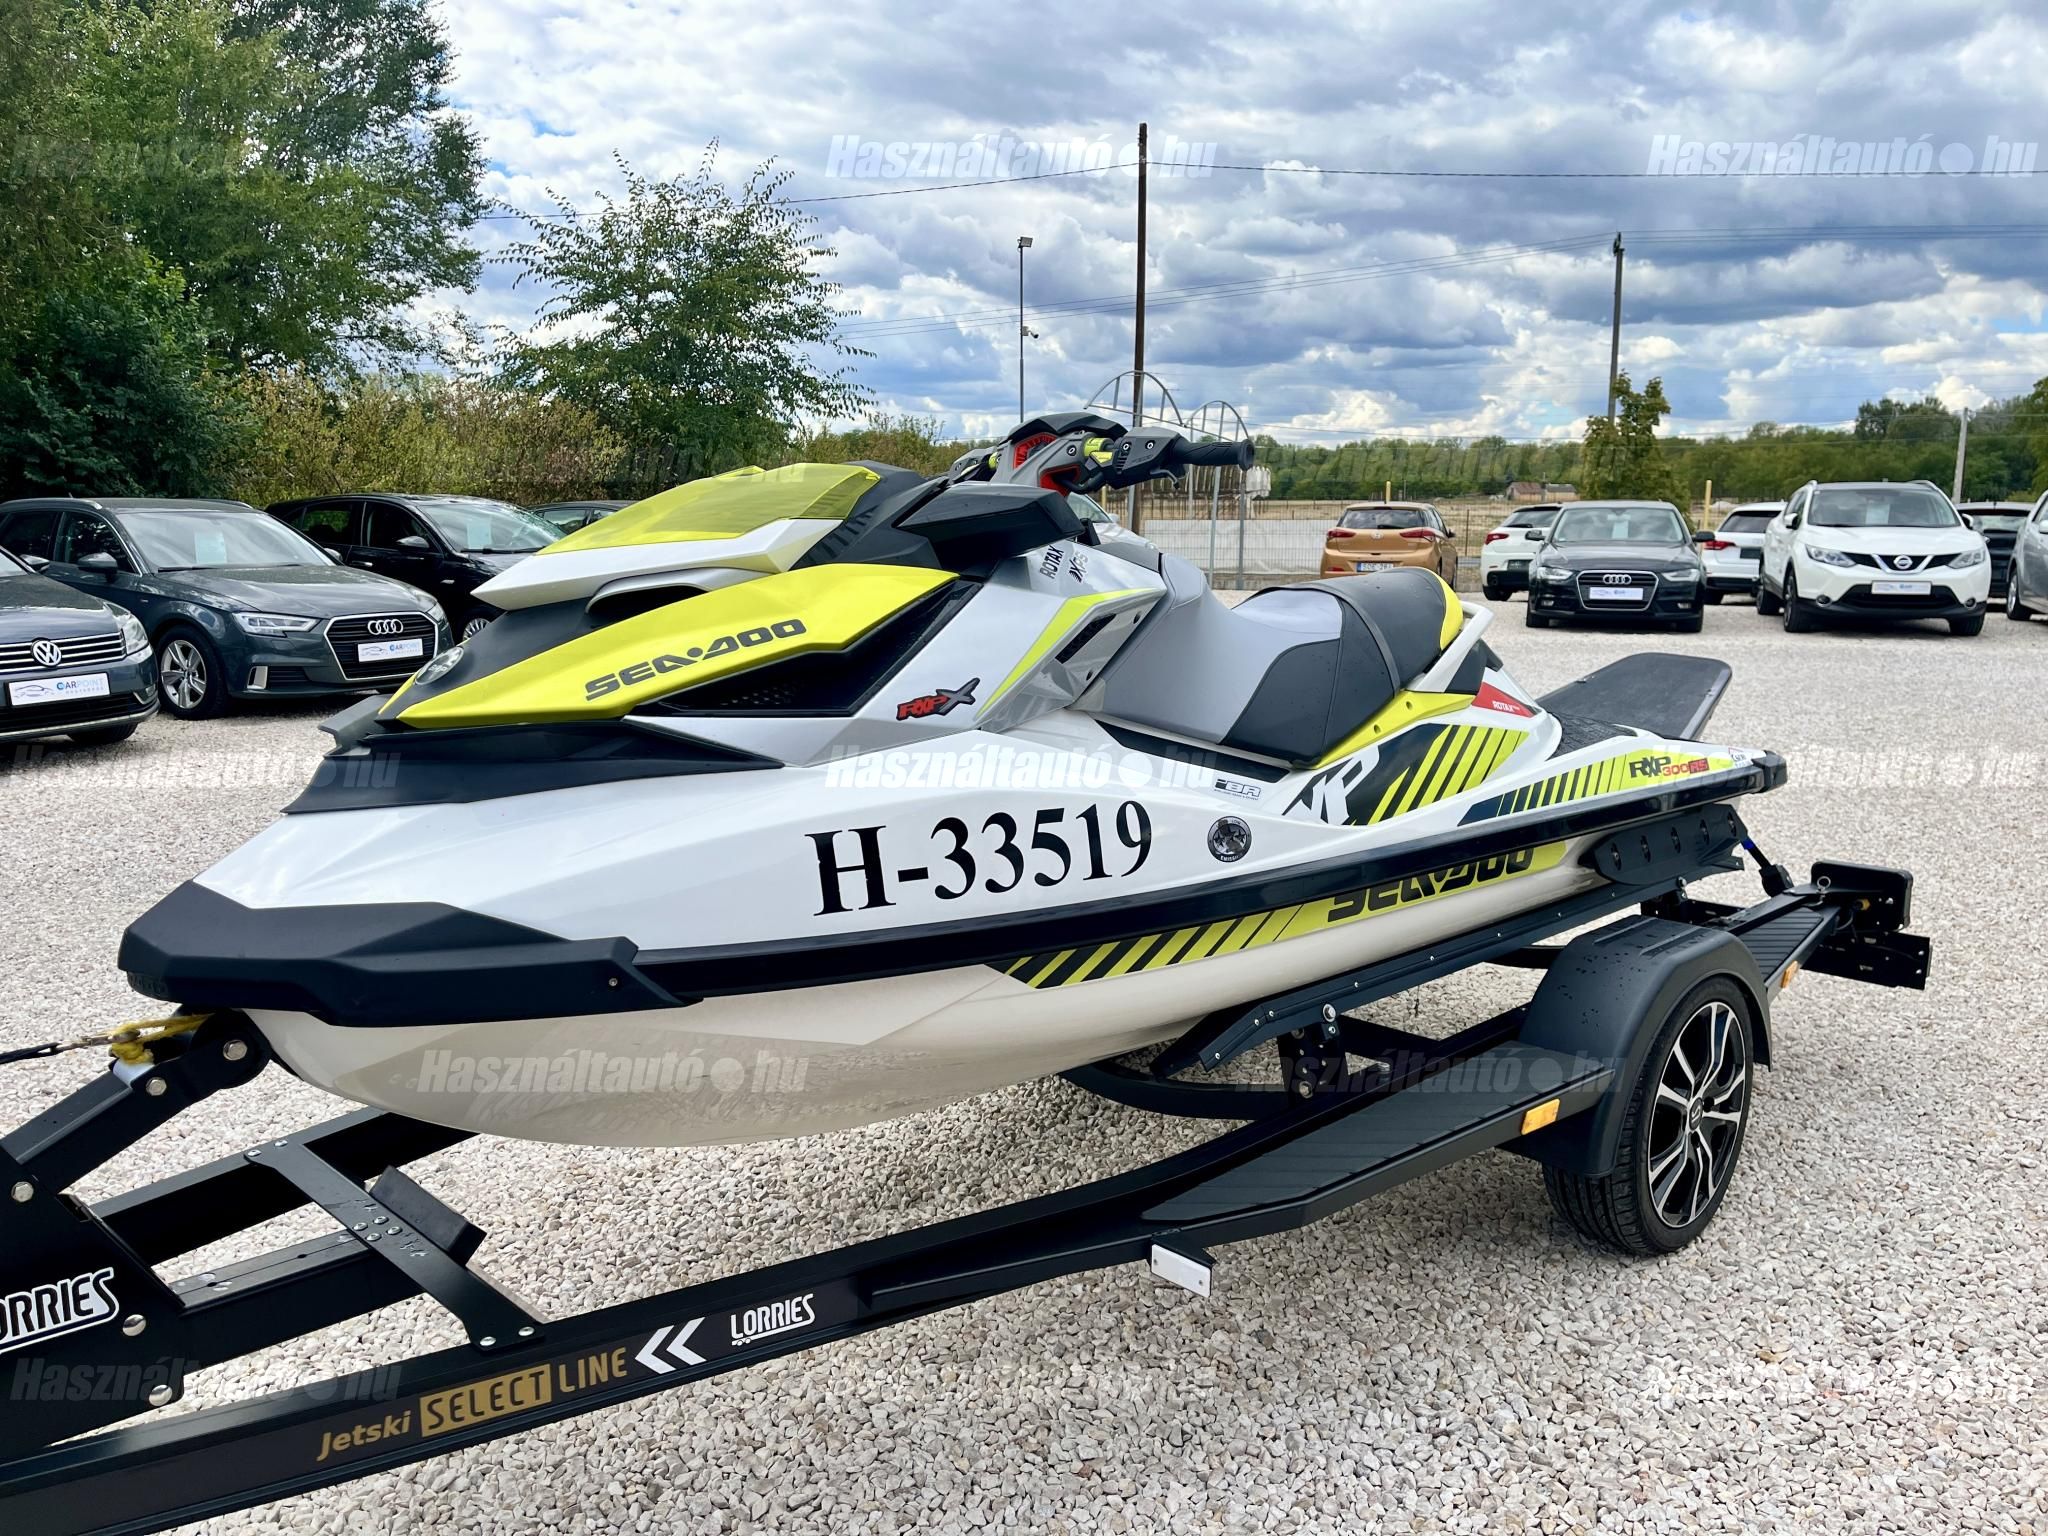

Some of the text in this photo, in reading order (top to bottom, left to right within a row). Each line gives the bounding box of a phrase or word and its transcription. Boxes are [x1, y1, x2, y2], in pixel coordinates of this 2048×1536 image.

[1039, 545, 1064, 579] ROTAX
[805, 800, 1152, 916] H-33519
[731, 1294, 816, 1347] LORRIES
[316, 1347, 628, 1461] Jetski SELECT LINE
